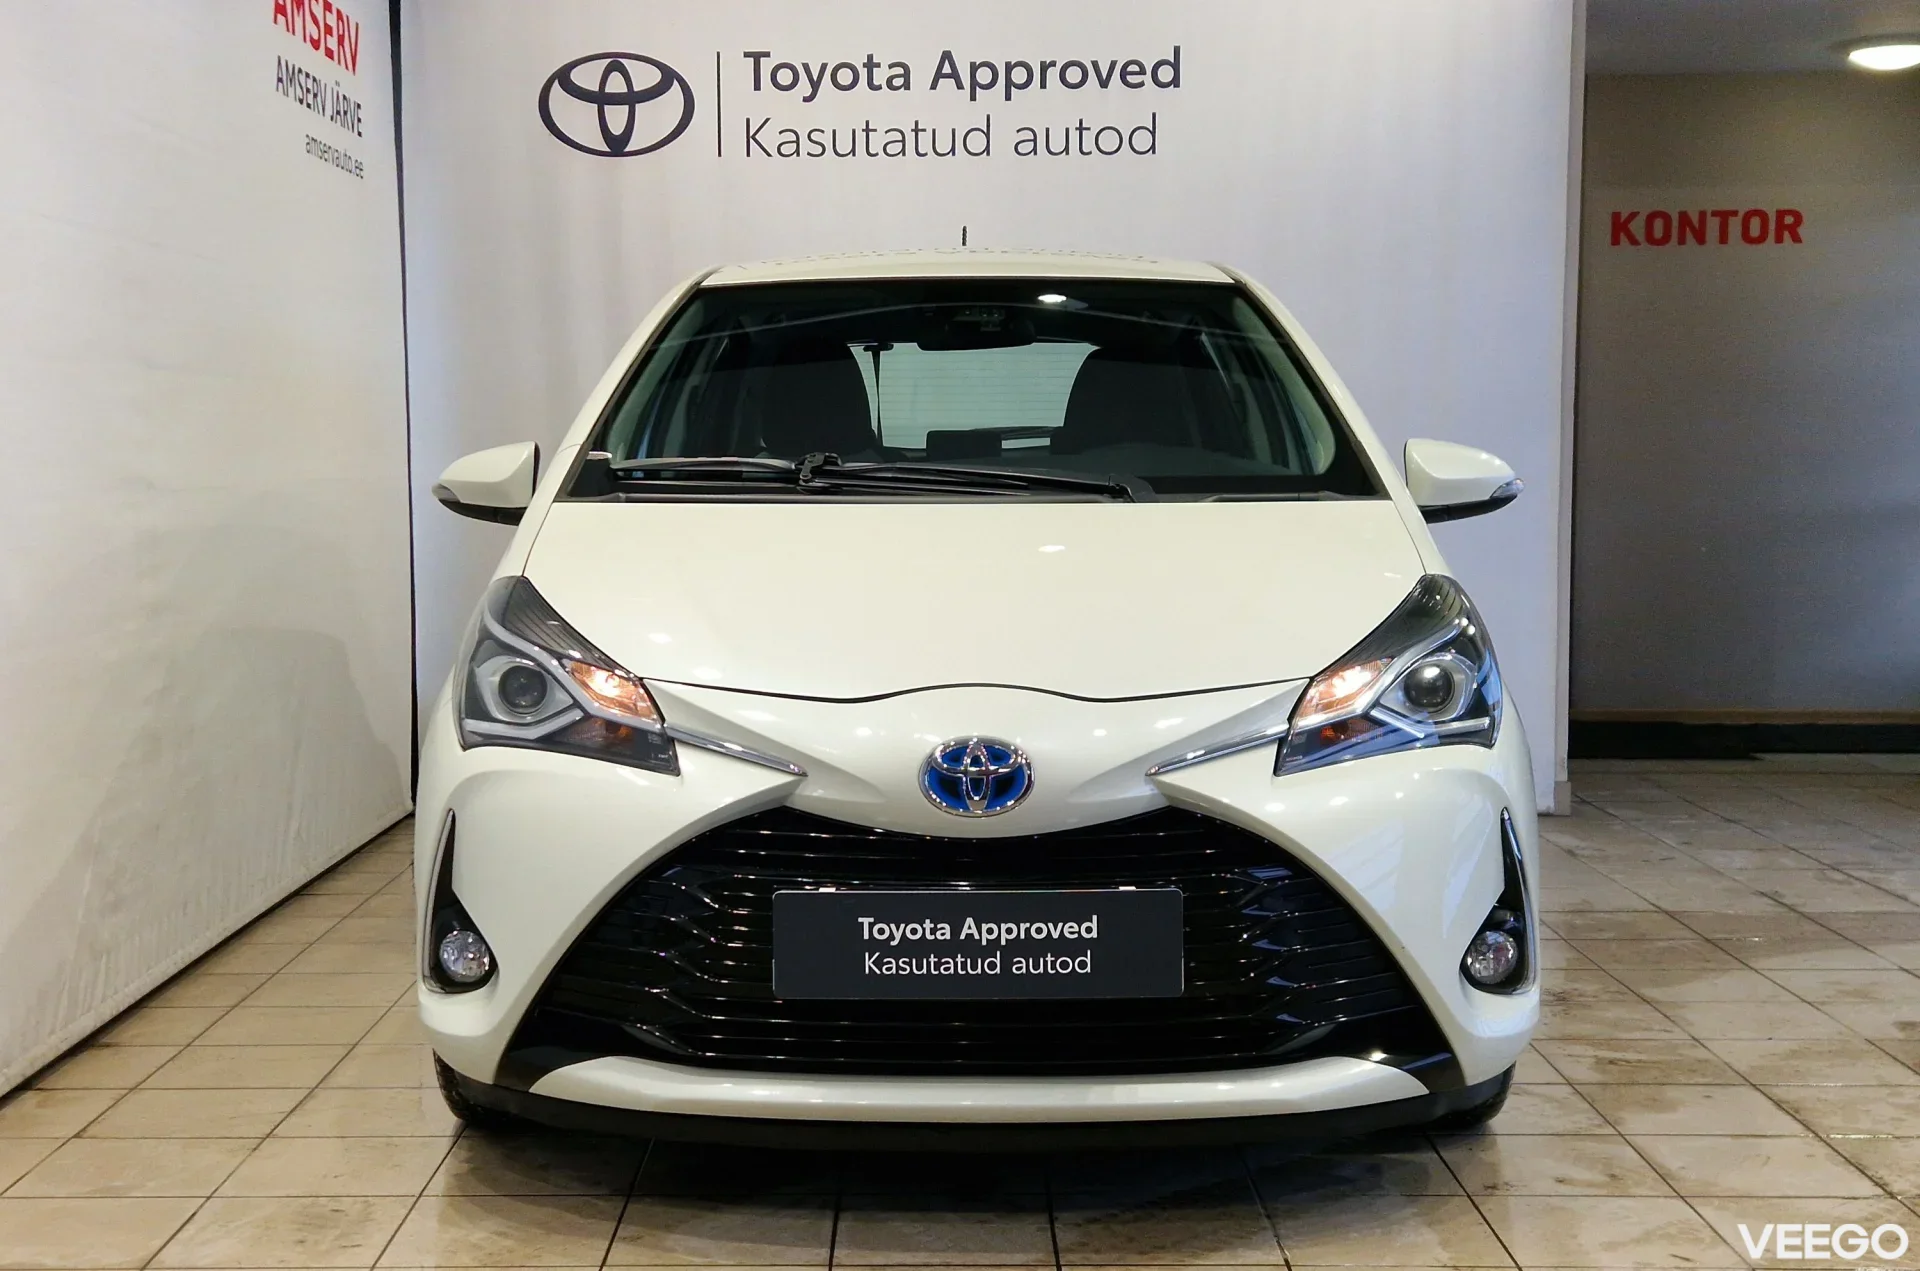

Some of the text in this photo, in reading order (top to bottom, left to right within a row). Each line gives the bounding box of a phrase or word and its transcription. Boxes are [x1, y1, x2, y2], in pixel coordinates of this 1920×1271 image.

[276, 55, 363, 138] AMSERV JÄRVE
[744, 46, 1181, 102] Toyota Approved
[305, 134, 364, 179] amservauto.ee
[745, 112, 1158, 158] Kasutatud autod
[1610, 209, 1804, 247] KONTOR
[858, 915, 1098, 946] Toyota Approved
[864, 950, 1091, 975] Kasutatud autod
